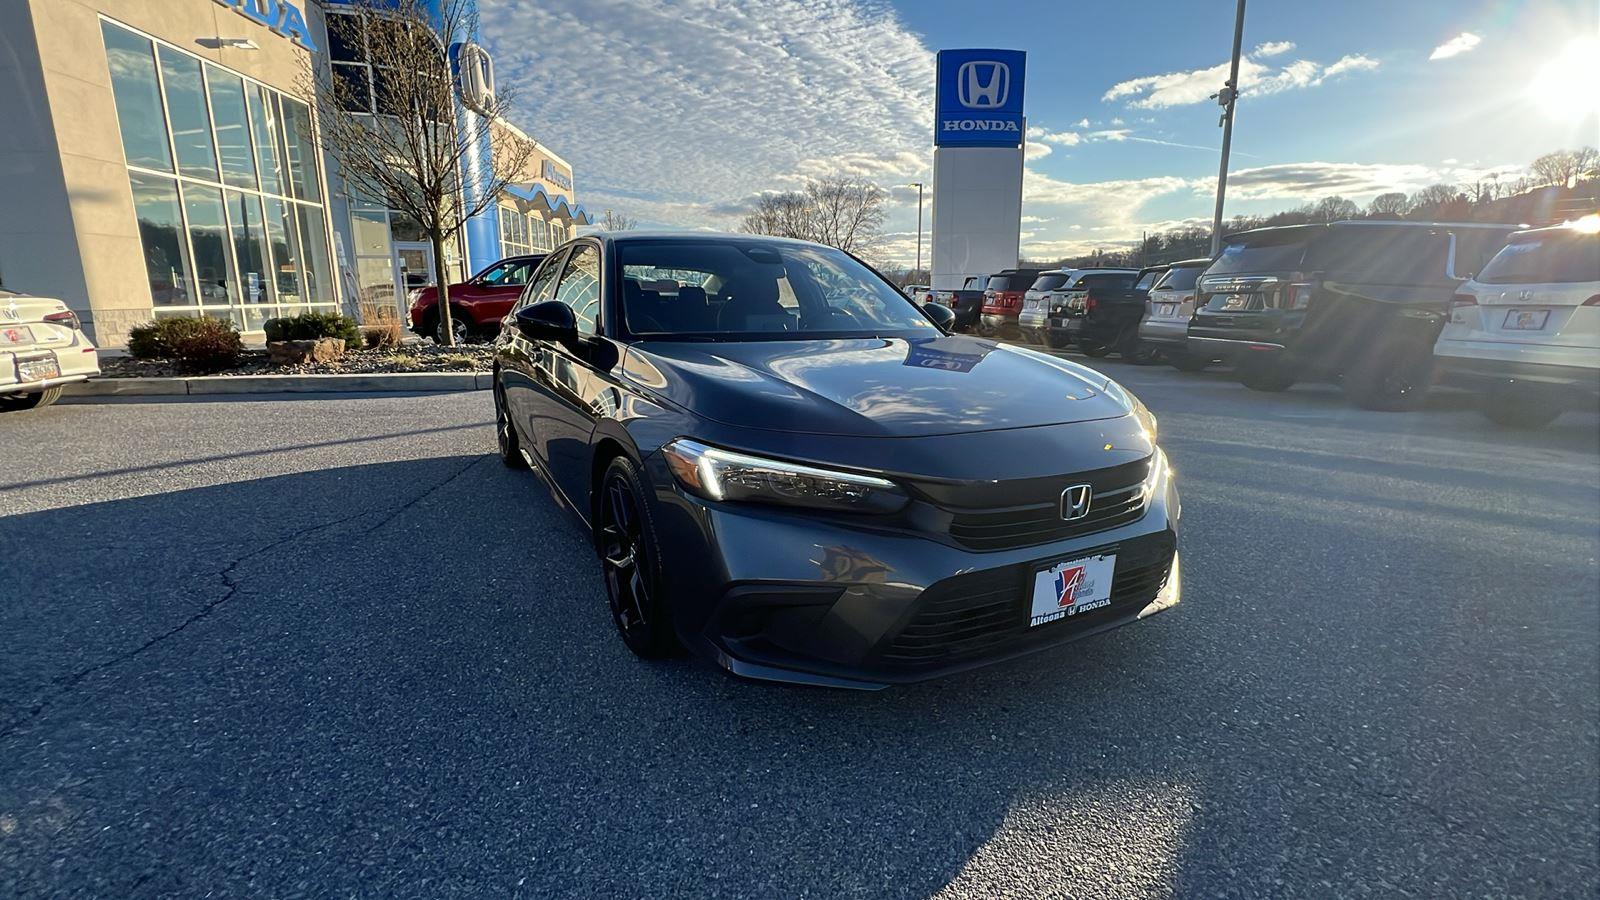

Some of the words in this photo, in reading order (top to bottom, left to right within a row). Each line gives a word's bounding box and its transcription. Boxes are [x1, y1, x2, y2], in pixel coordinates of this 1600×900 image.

[943, 119, 1019, 131] HONDA
[1030, 611, 1066, 627] Altoona
[1078, 598, 1111, 613] HONDA
